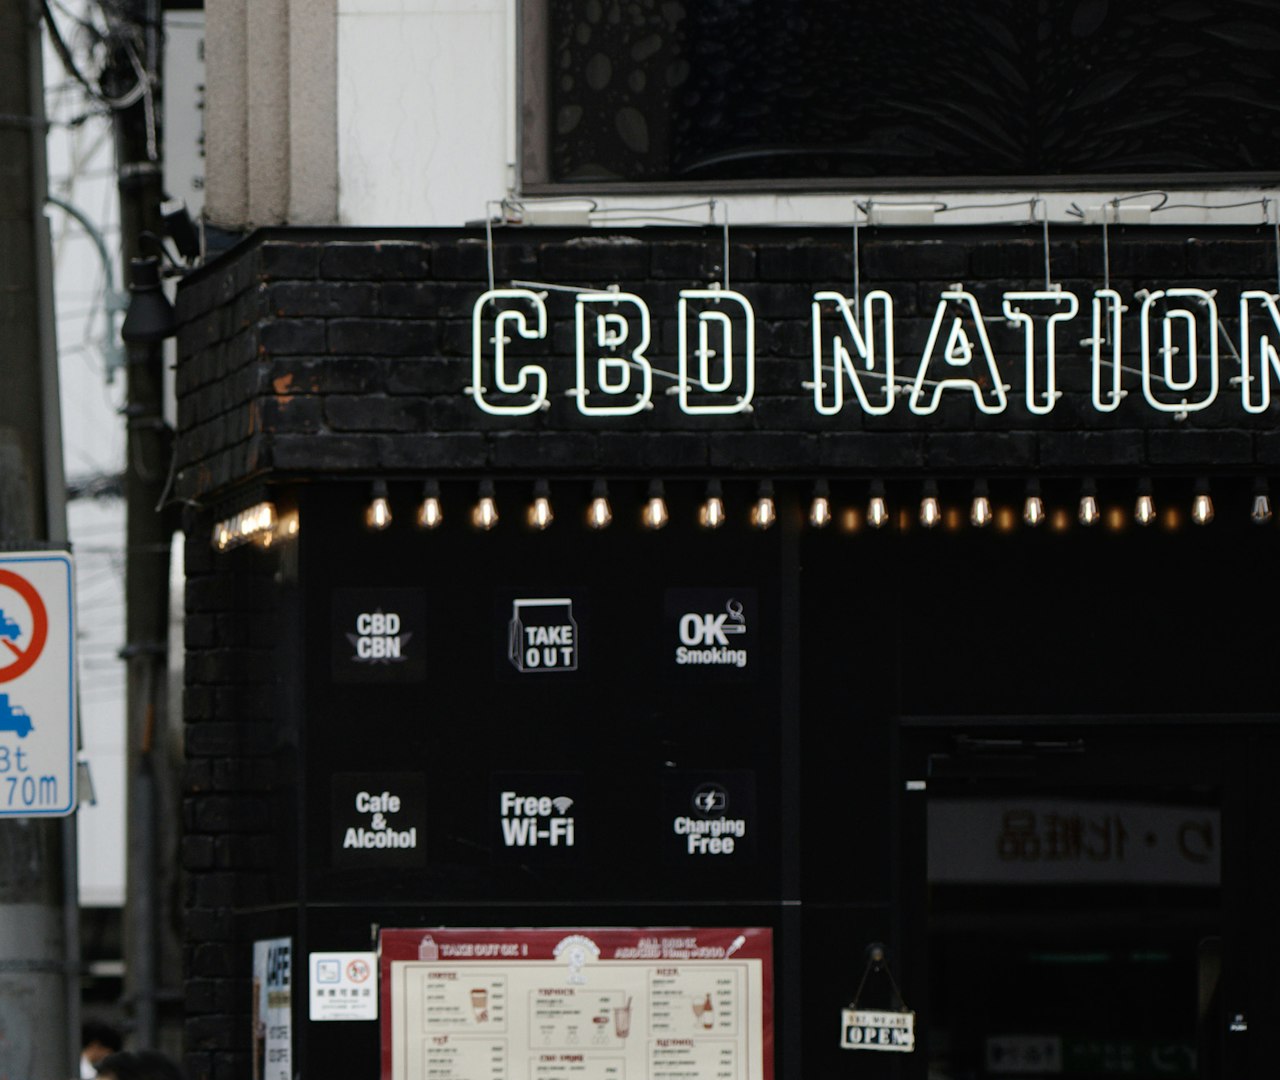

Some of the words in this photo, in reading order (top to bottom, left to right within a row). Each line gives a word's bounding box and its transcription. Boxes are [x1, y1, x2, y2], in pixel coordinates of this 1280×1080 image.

[472, 288, 755, 417] CBD
[357, 613, 400, 636] CBD
[679, 613, 729, 646] OK
[525, 625, 573, 646] TAKE
[357, 636, 400, 659] CBN
[526, 647, 574, 667] OUT
[676, 647, 746, 668] Smoking
[5, 775, 58, 806] 70m
[356, 792, 401, 813] Cafe
[501, 791, 552, 816] Free
[372, 813, 386, 830] &
[502, 818, 574, 846] Wi-Fi
[674, 817, 745, 838] Charging
[344, 828, 416, 849] Alcohol
[688, 834, 734, 855] Free
[849, 1026, 908, 1046] OPEN
